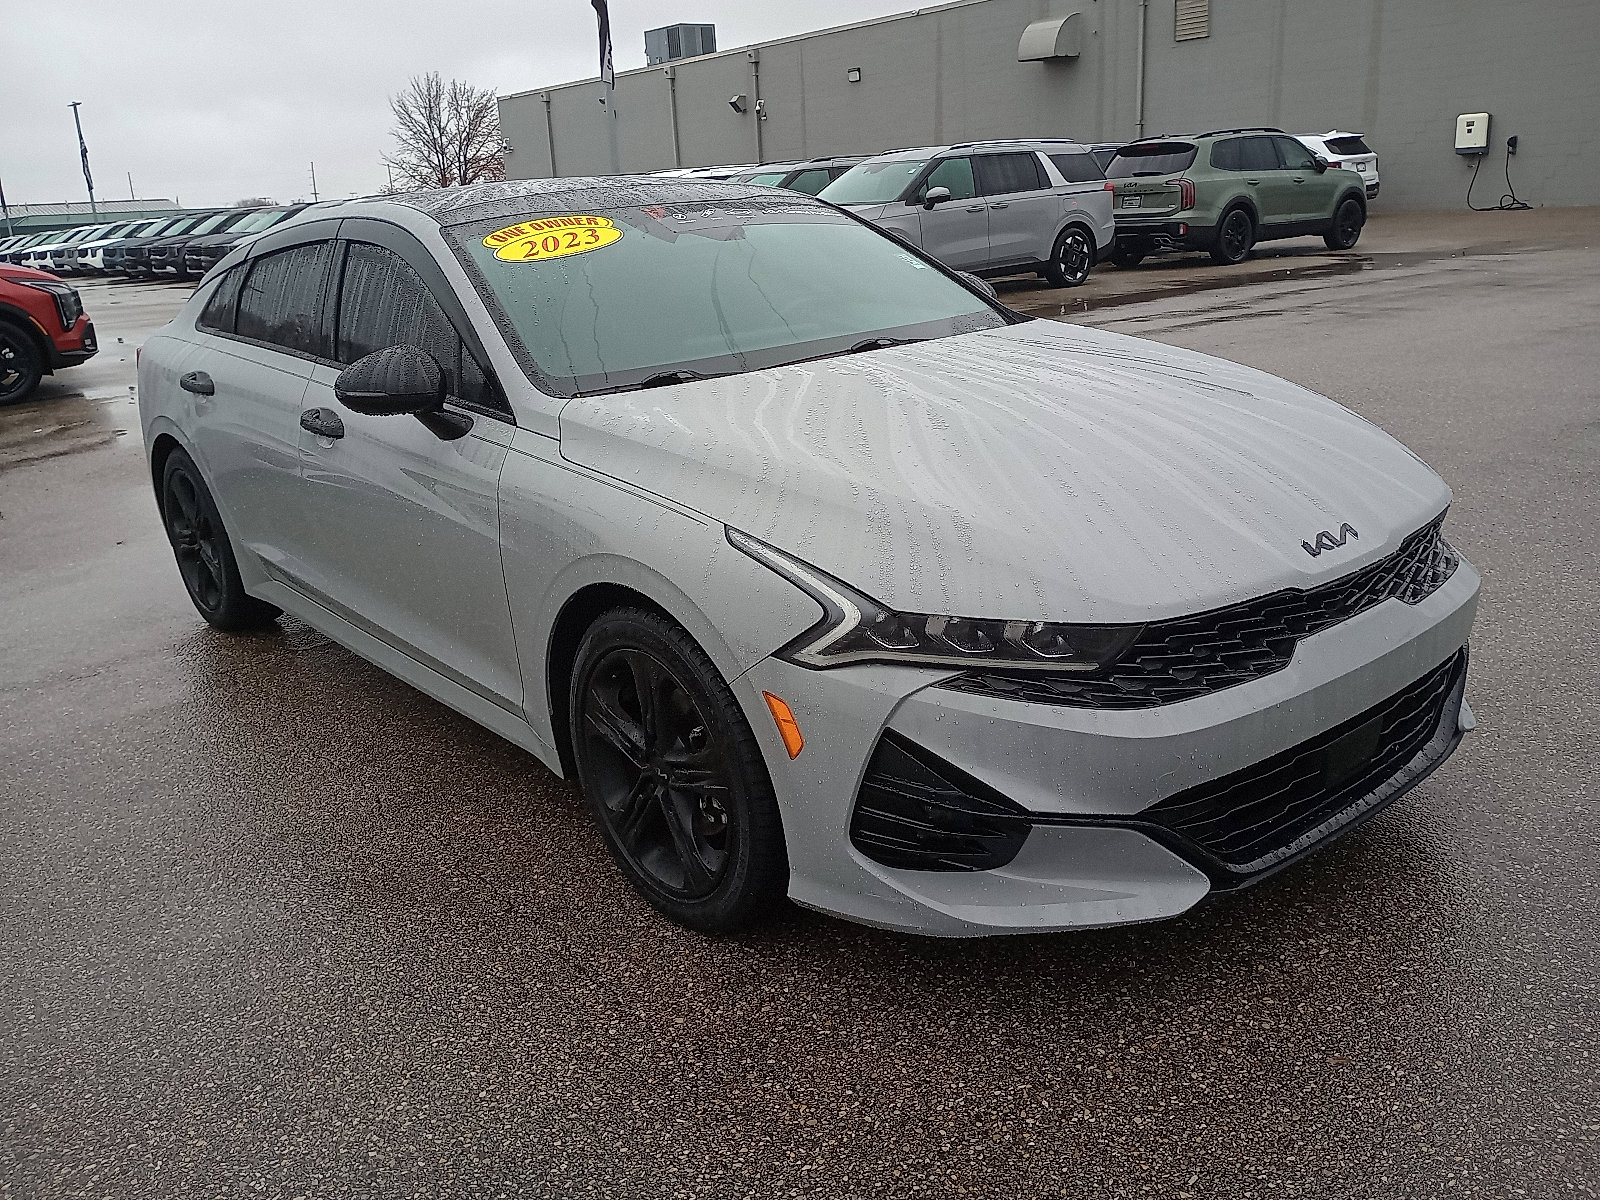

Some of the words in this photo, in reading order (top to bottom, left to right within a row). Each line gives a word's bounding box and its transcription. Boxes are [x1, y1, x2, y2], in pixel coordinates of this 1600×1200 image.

[490, 226, 530, 243] ONE
[529, 217, 599, 231] OWNER
[521, 229, 600, 259] 2023
[1301, 522, 1359, 558] KIA
